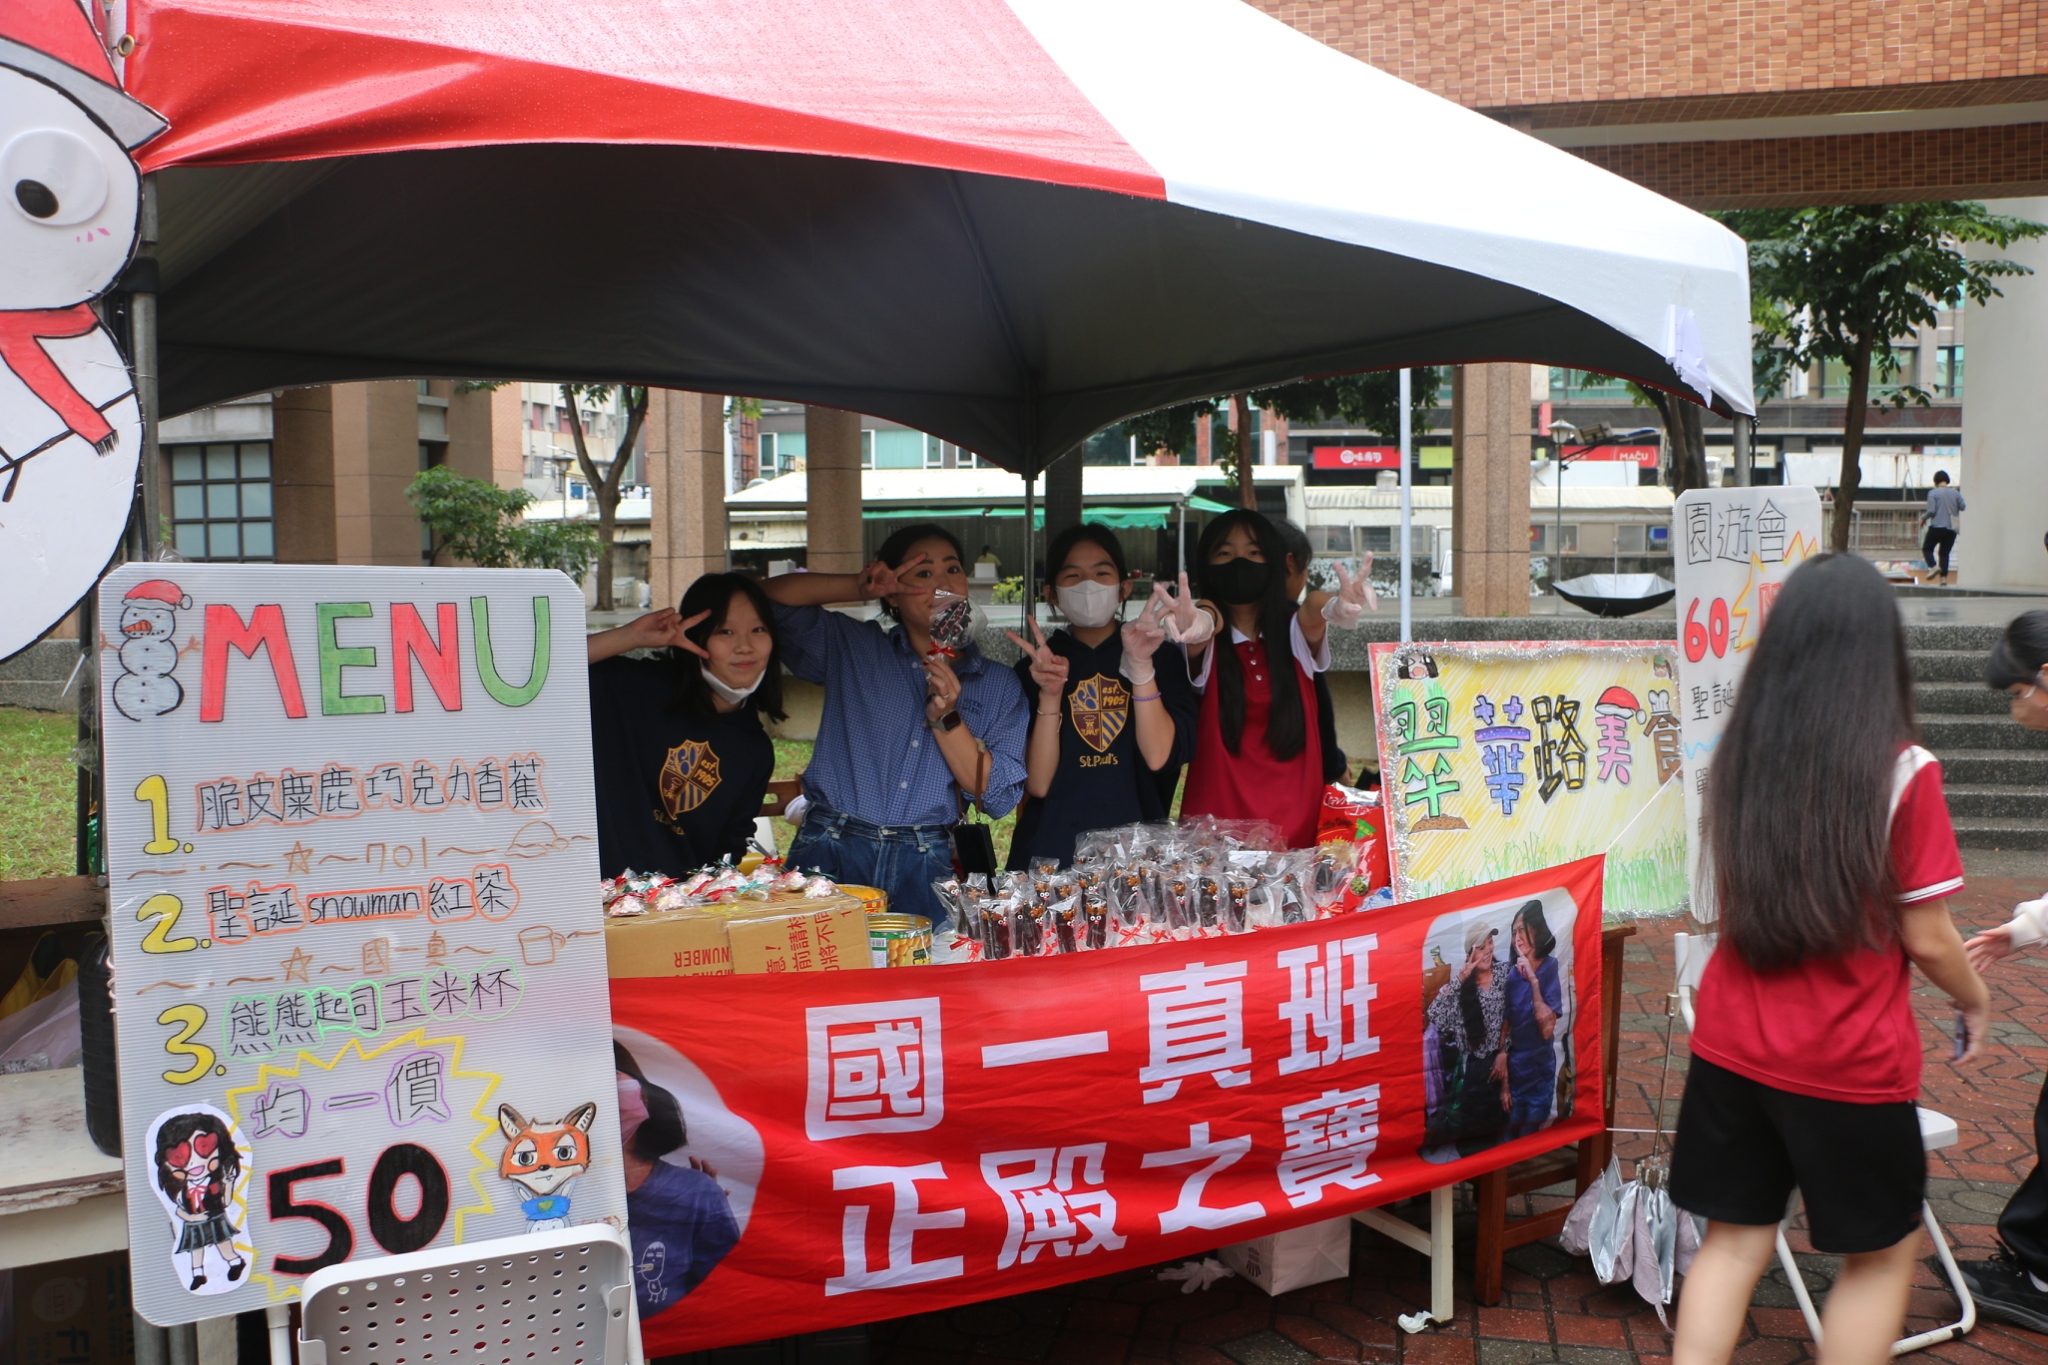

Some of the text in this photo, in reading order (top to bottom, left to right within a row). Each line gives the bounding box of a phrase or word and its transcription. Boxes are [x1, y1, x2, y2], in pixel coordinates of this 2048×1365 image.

[1685, 498, 1788, 565] 園遊會
[200, 596, 551, 722] MENU
[1102, 695, 1126, 707] 1905
[693, 768, 717, 787] 1905
[1390, 686, 1683, 816] 翠華路美食
[674, 946, 730, 969] NUMBER
[230, 968, 521, 1057] 熊熊起司玉米杯
[805, 933, 1381, 1142] 國一真班
[255, 1056, 448, 1136] 均一價
[265, 1142, 452, 1277] 50
[824, 1082, 1383, 1297] 正殿之寶
